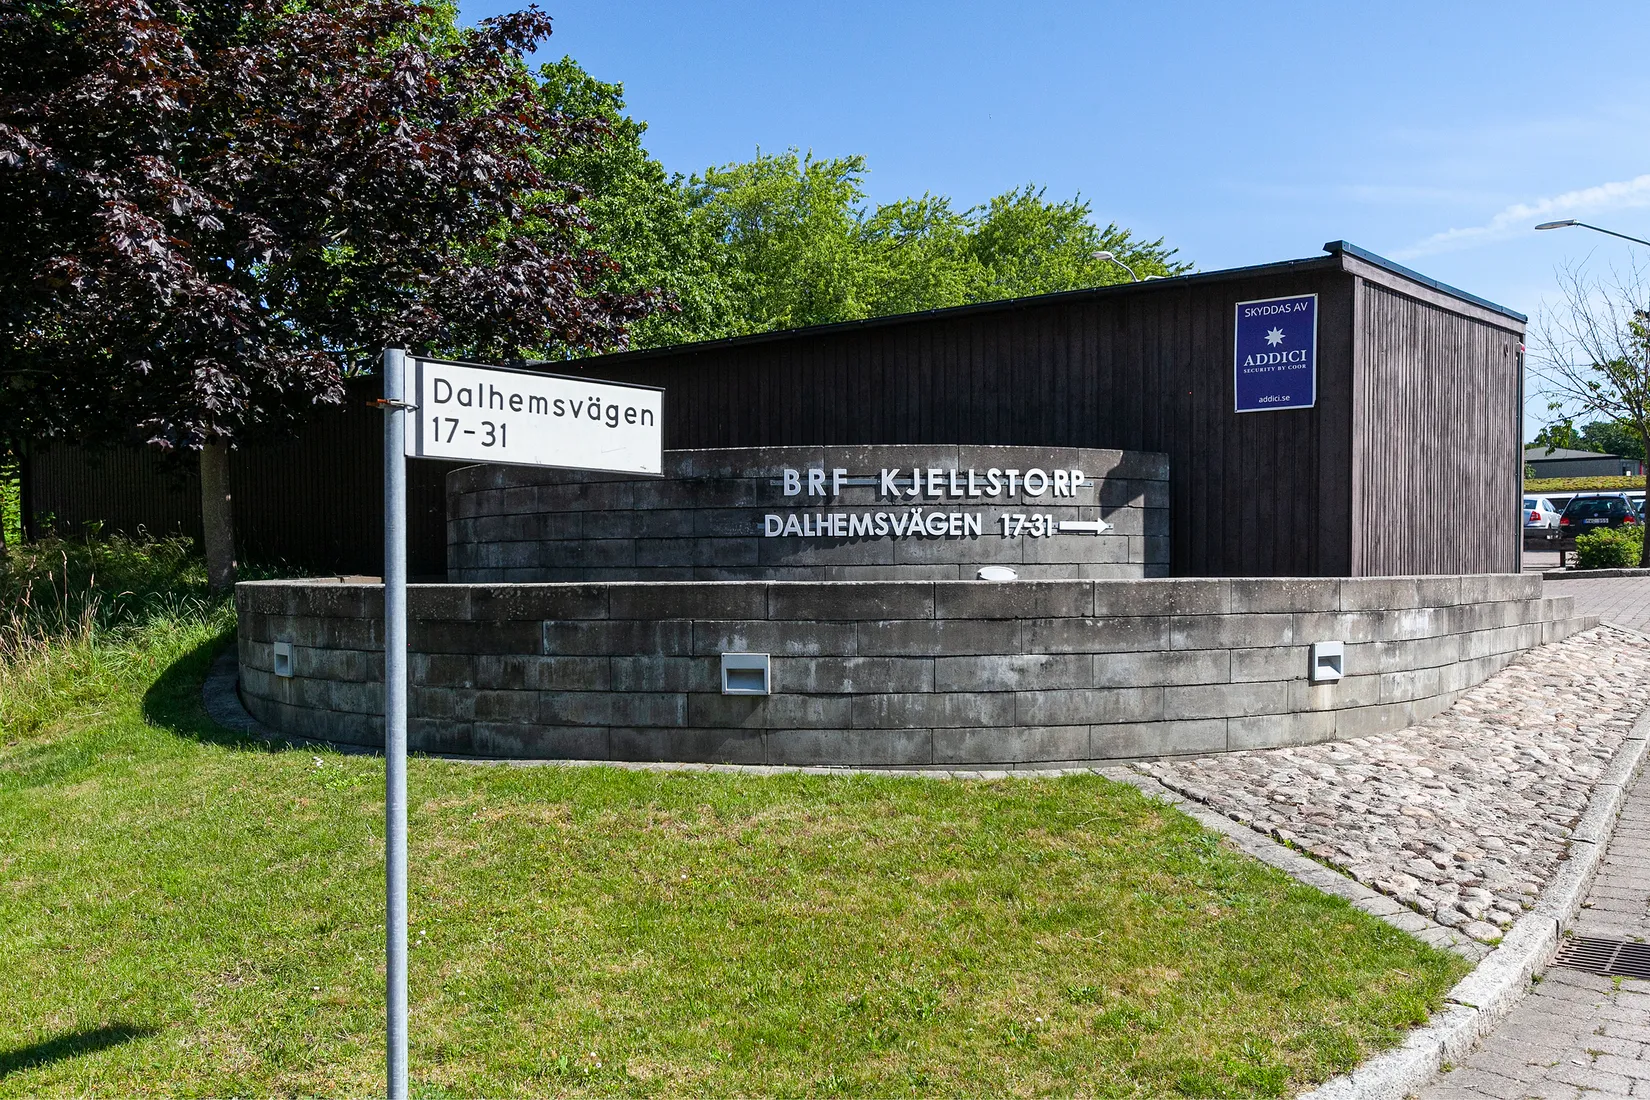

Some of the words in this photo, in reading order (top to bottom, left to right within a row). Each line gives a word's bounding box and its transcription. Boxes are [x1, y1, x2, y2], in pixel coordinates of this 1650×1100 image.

[1244, 303, 1291, 317] SKYDDAS
[1293, 302, 1308, 312] AV
[1243, 349, 1307, 366] ADDICI
[433, 377, 654, 428] Dalhemsvägen
[1258, 395, 1290, 403] addici.se
[432, 416, 506, 448] 17-31
[783, 468, 848, 497] BRF
[881, 468, 1085, 497] KJELLSTORP
[764, 507, 982, 537] DALHEMSVÄGEN
[1000, 513, 1053, 538] 17-31
